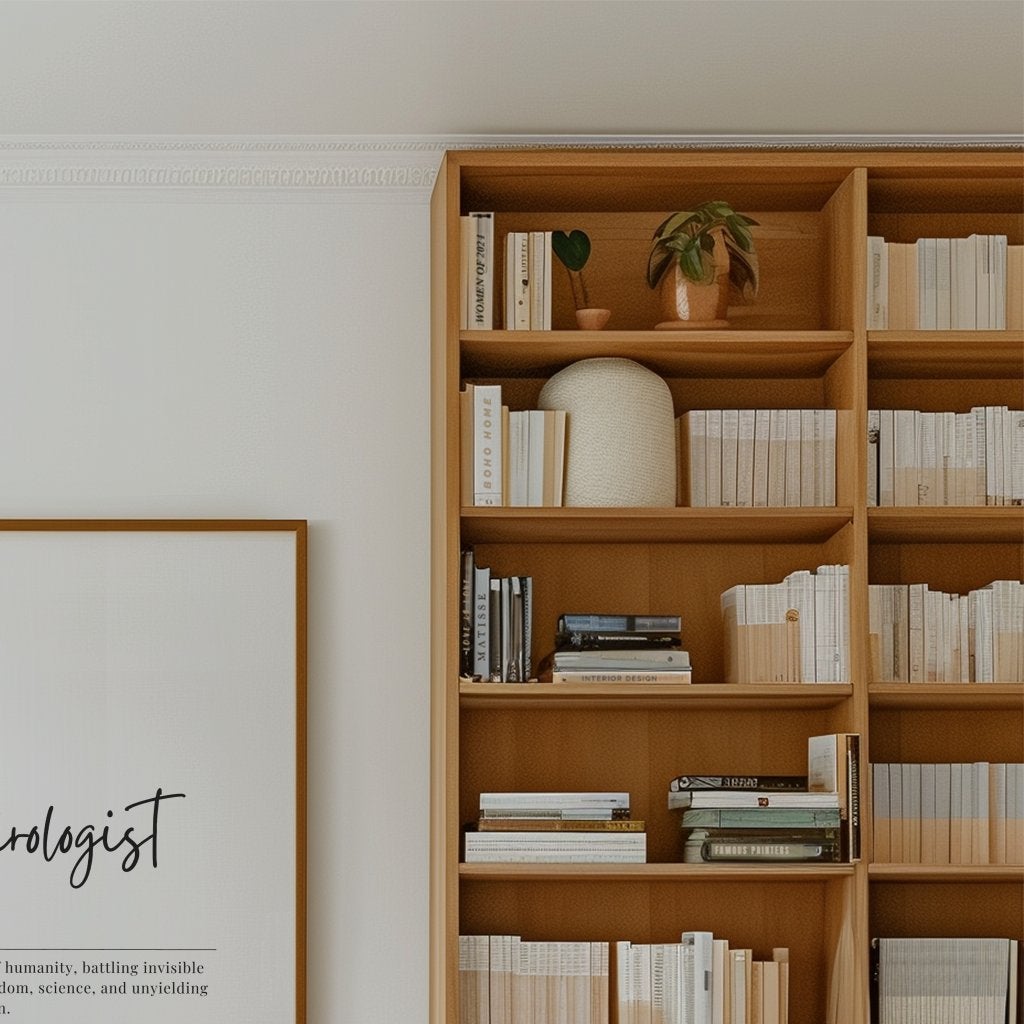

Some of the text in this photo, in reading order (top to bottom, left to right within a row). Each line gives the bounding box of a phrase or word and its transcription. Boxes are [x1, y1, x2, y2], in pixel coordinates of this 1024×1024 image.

[476, 261, 485, 276] OF
[476, 279, 485, 322] WOMEN
[483, 398, 492, 489] BOHO HOME
[477, 593, 487, 661] MATISSE
[714, 845, 748, 855] FAMOUS
[5, 961, 78, 977] humanity,
[82, 961, 139, 977] battling
[143, 961, 204, 974] invisible
[38, 981, 96, 996] science,
[100, 981, 127, 994] and
[132, 981, 209, 997] unyielding
